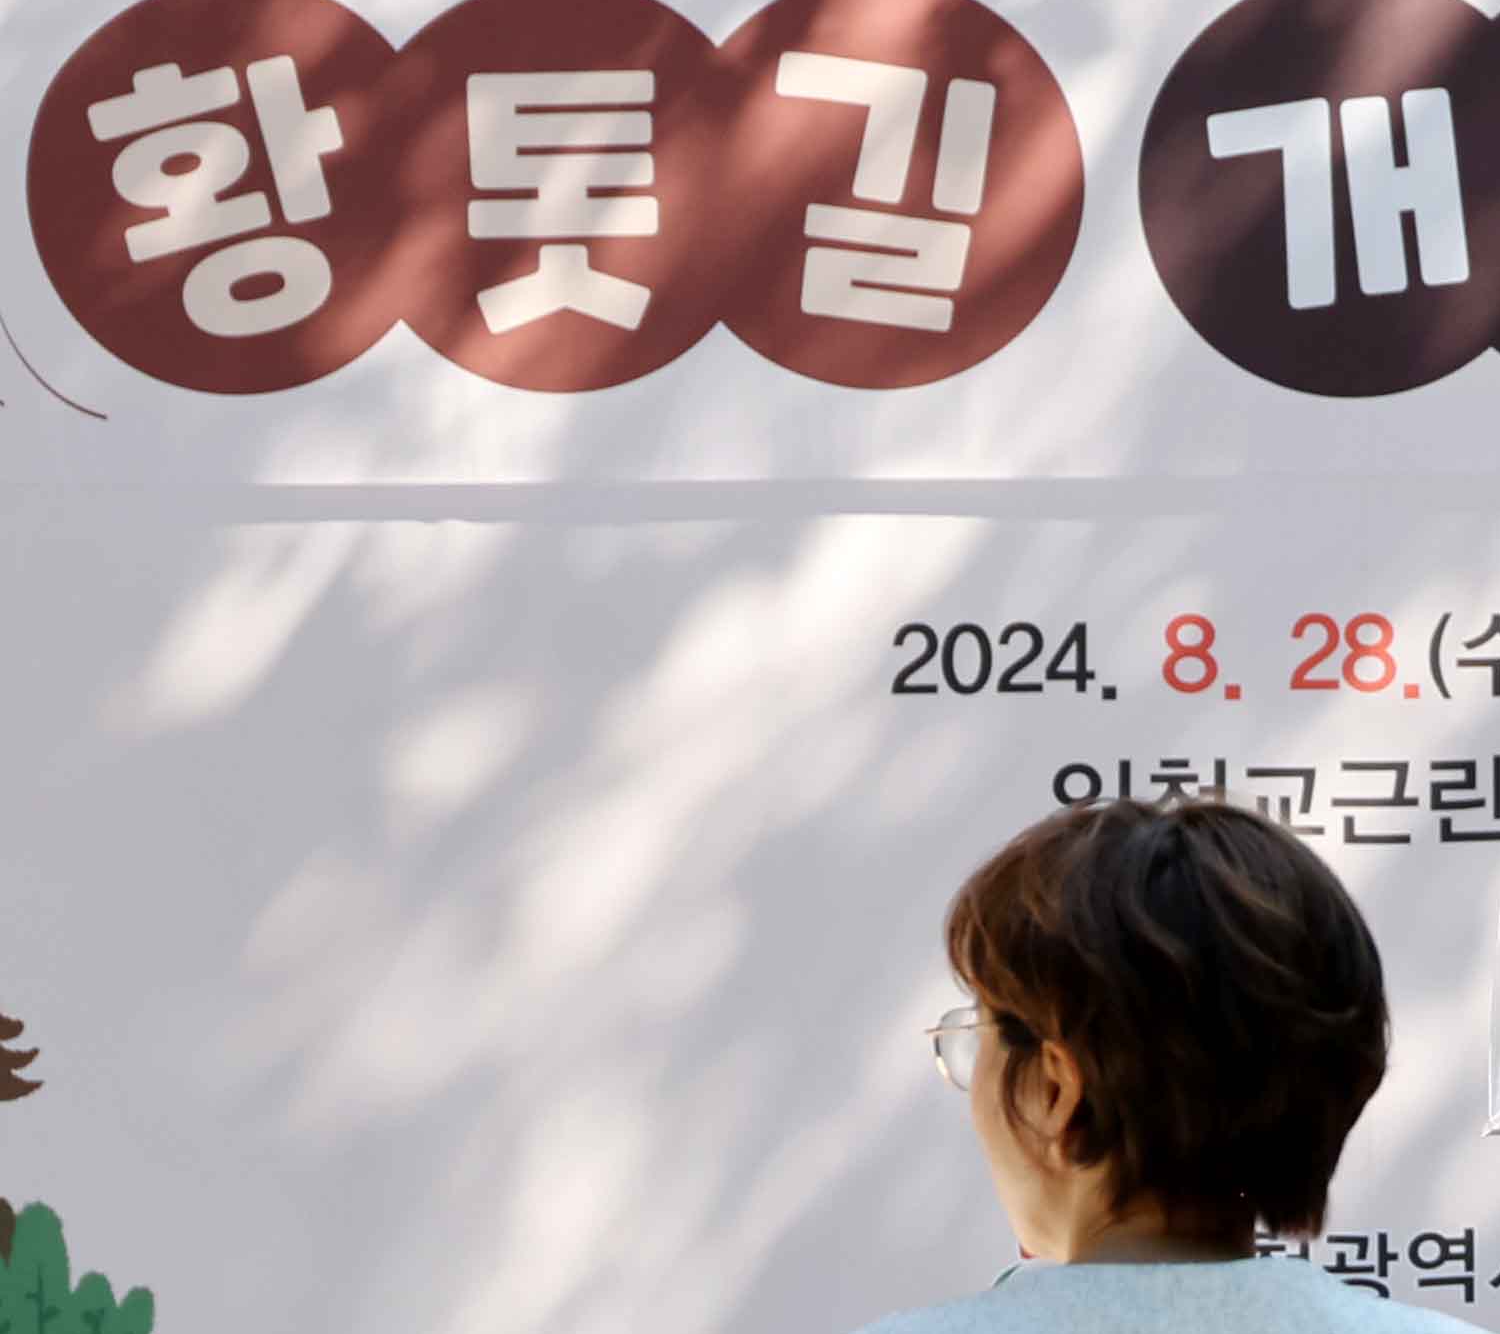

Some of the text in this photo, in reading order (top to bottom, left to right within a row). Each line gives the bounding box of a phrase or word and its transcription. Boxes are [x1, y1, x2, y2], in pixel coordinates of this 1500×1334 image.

[87, 50, 998, 339] 황톳길
[891, 621, 1118, 701] 2024.
[1161, 613, 1242, 701] 8.
